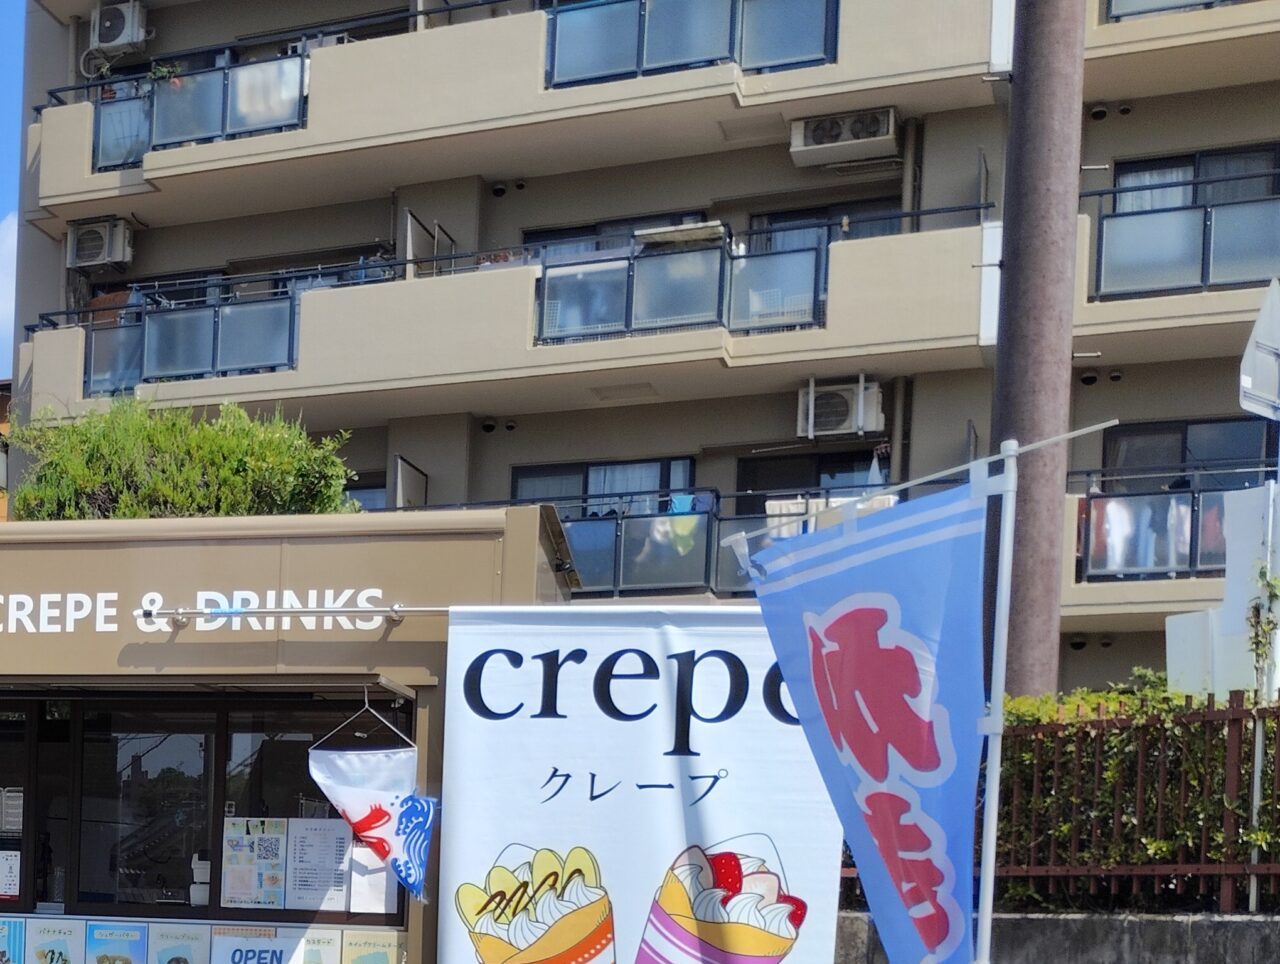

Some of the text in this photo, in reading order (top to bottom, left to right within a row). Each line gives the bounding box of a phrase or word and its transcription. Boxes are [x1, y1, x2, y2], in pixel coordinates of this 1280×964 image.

[135, 591, 174, 633] &
[195, 588, 383, 631] DRINKS
[539, 766, 729, 806] クレープ
